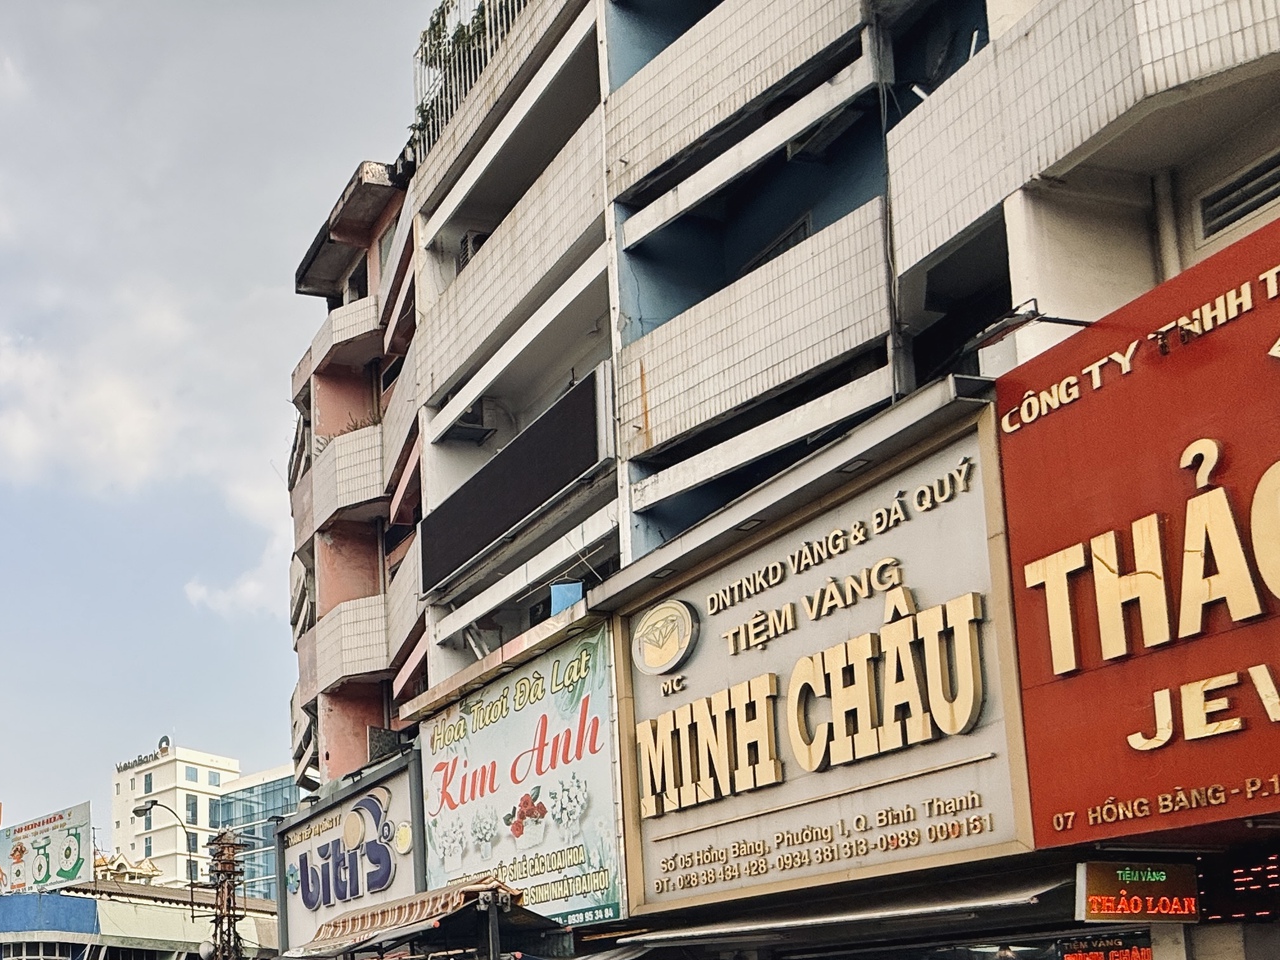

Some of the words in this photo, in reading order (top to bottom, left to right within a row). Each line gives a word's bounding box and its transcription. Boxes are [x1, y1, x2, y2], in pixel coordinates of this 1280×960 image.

[1001, 376, 1080, 434] CÔNG
[1082, 339, 1142, 390] TY
[1147, 281, 1254, 355] TNHH
[706, 560, 785, 616] DNTNKD
[787, 528, 849, 576] VÀNG
[849, 521, 868, 545] &
[871, 490, 908, 535] ĐÁ
[912, 456, 975, 514] QUÝ
[722, 602, 797, 656] TIỆM
[800, 556, 902, 621] VÀNG
[432, 715, 467, 755] Hoa
[470, 686, 510, 734] Tươi
[513, 670, 546, 712] Đà
[550, 649, 592, 694] Lạt
[636, 672, 783, 819] MINH
[787, 586, 983, 773] CHÂU
[660, 675, 685, 697] MC
[116, 749, 160, 774] VietinBank
[428, 755, 500, 818] Kim
[510, 694, 605, 785] Anh
[1052, 811, 1075, 831] 07
[1087, 796, 1151, 825] HỒNG
[1157, 786, 1227, 814] BÀNG
[659, 852, 678, 874] Số
[678, 853, 694, 869] 05
[695, 845, 728, 866] Hồng
[774, 825, 833, 849] Phường
[853, 814, 873, 833] Q.
[875, 804, 916, 828] Bình
[921, 790, 982, 818] Thạnh
[528, 852, 546, 877] CÁC
[546, 848, 567, 874] LOẠI
[566, 844, 586, 868] HOA
[701, 869, 716, 884] 38
[718, 864, 740, 882] 434
[743, 859, 768, 877] 428
[775, 851, 811, 872] 0934
[814, 846, 840, 864] 381
[1116, 867, 1140, 884] TIỆM
[1140, 867, 1167, 882] VÀNG
[530, 883, 551, 906] SINH
[550, 875, 574, 903] NHẬT
[1088, 889, 1143, 914] THẢO
[1146, 896, 1197, 914] LOAN
